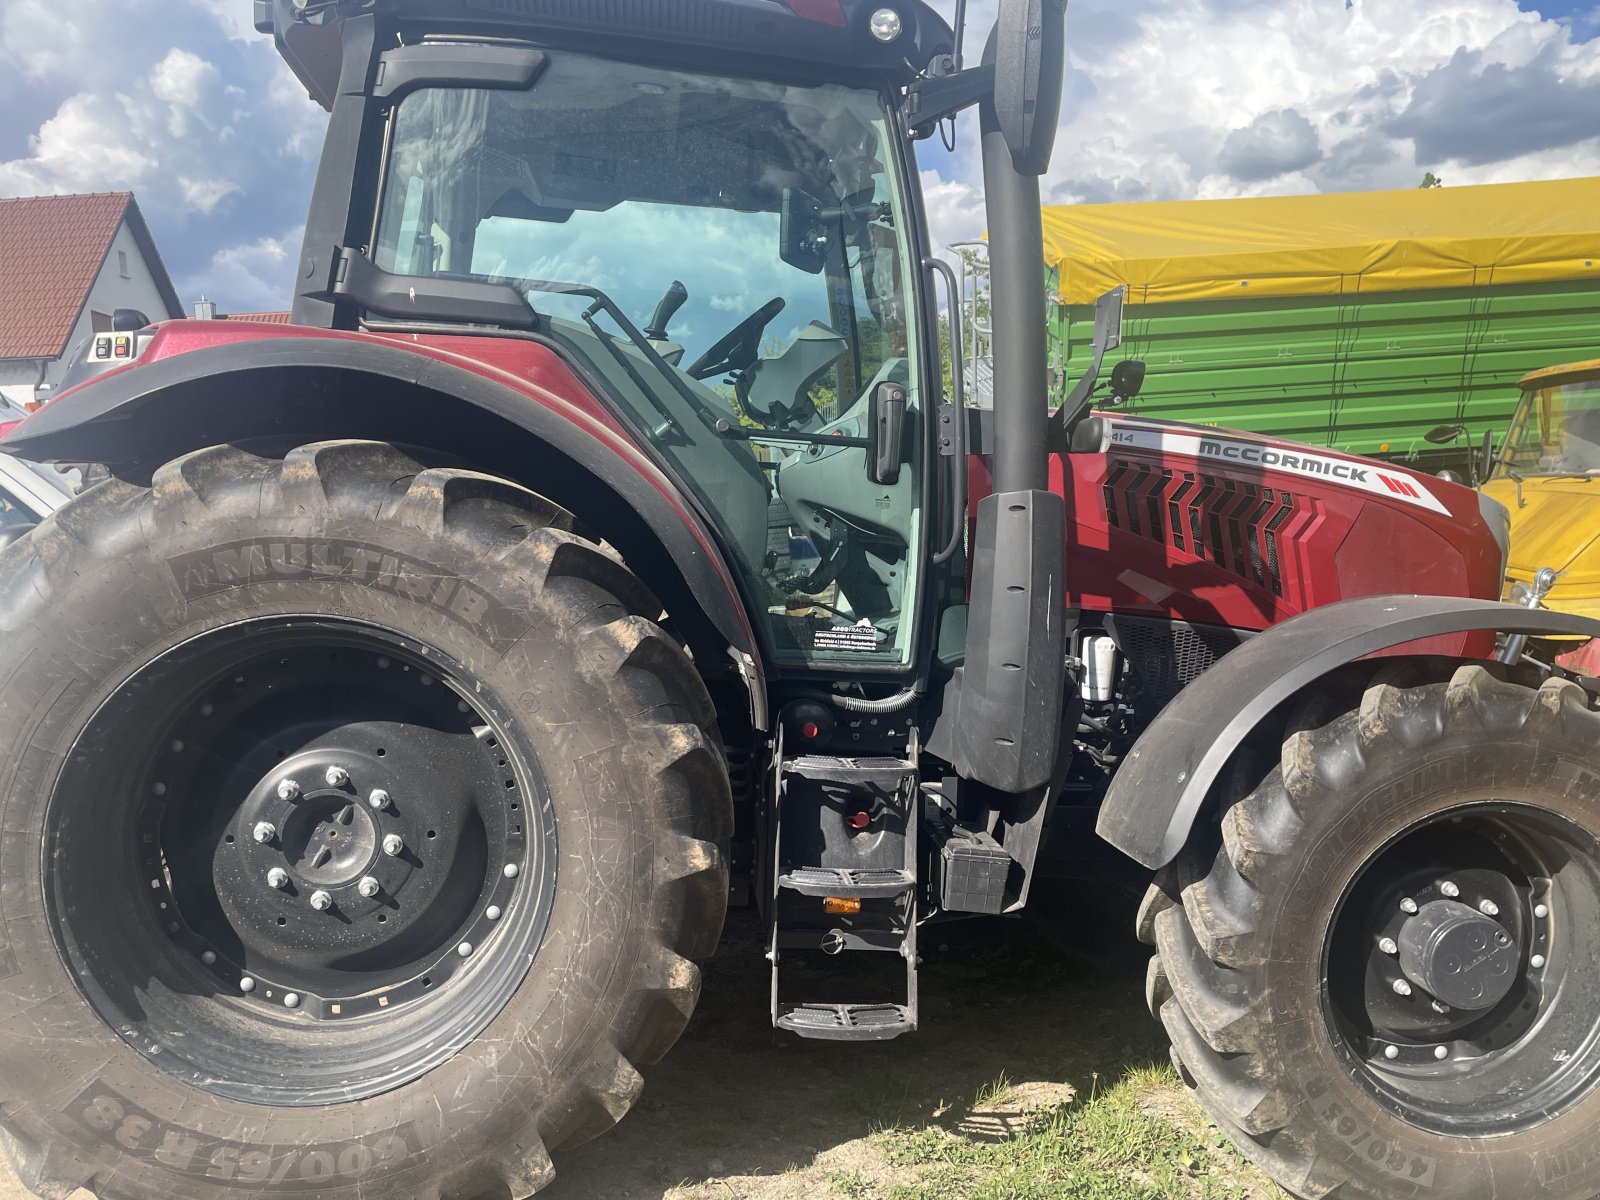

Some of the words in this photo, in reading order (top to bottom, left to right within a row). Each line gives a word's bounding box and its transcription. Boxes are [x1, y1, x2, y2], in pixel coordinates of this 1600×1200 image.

[211, 541, 489, 625] MULTIBIB
[81, 1094, 153, 1151] 38
[153, 1129, 200, 1172] R
[1320, 1101, 1428, 1180] 480/65
[205, 1132, 408, 1187] 600/65
